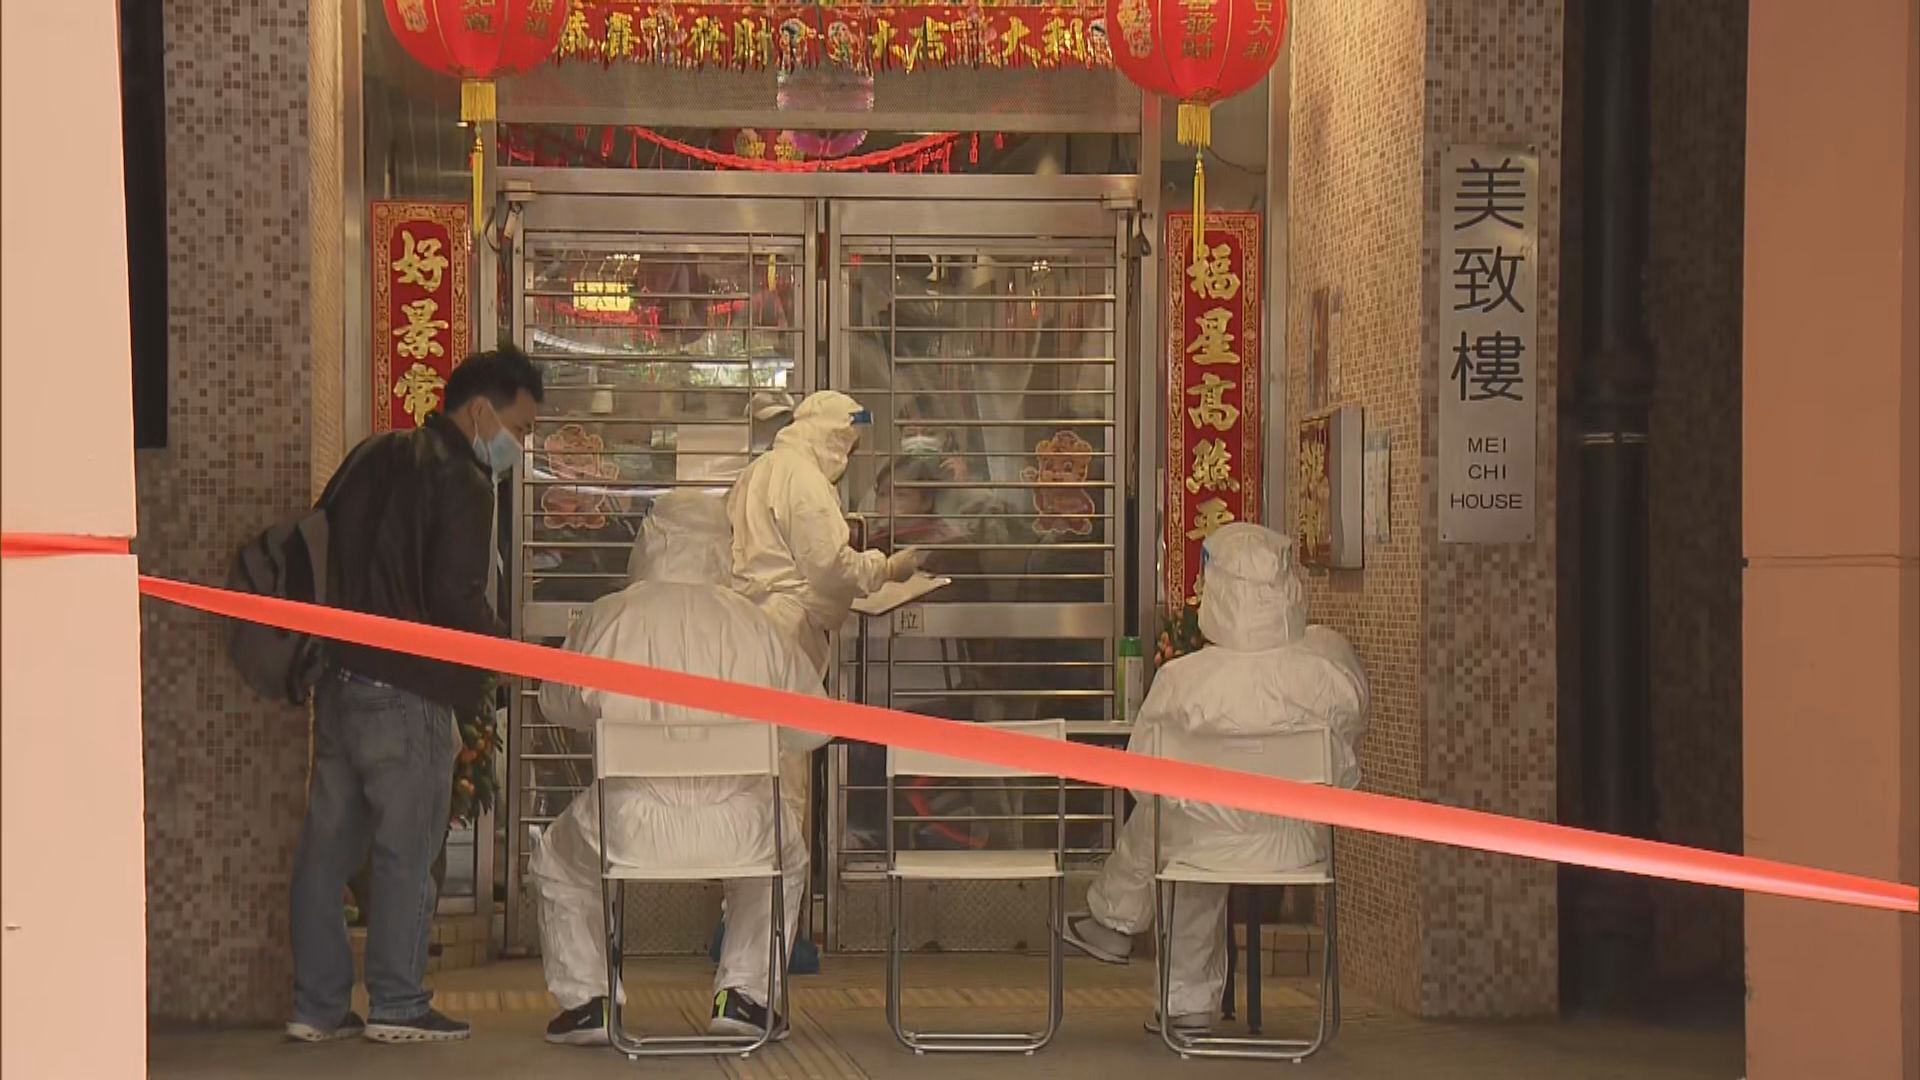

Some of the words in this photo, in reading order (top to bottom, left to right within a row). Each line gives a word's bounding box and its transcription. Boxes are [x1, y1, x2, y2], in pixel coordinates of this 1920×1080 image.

[1451, 158, 1526, 402] 美致樓
[1468, 437, 1507, 454] MEI
[1468, 464, 1507, 480] CHI
[1450, 493, 1523, 510] HOUSE
